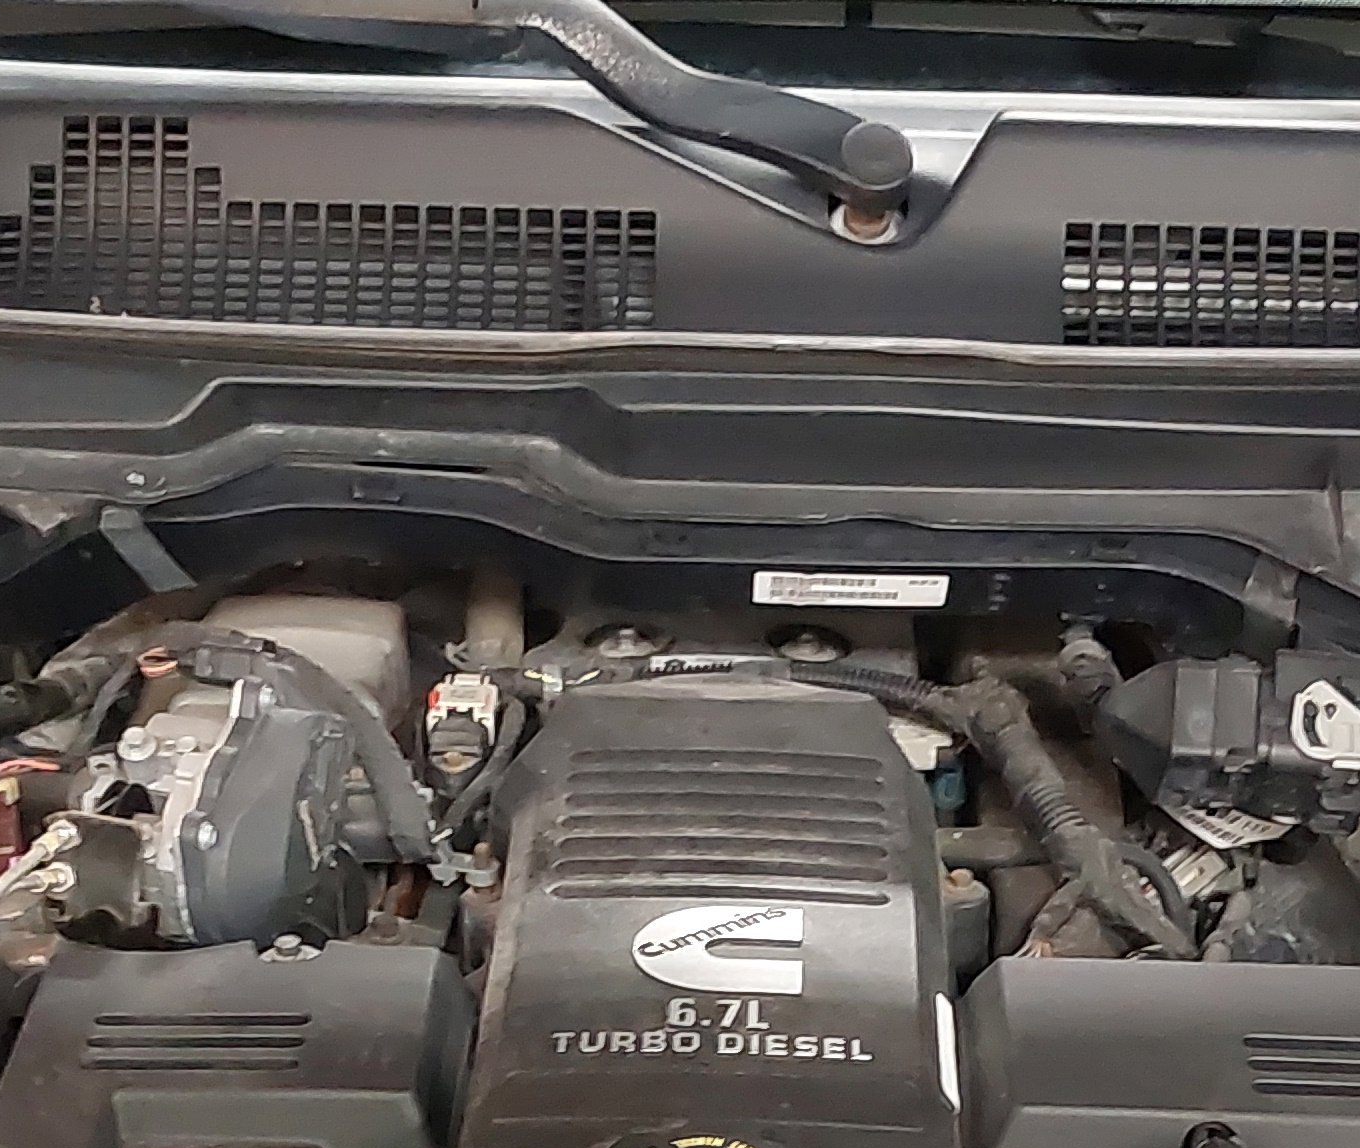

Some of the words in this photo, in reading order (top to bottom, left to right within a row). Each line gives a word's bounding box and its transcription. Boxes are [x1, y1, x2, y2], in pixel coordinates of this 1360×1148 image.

[638, 908, 786, 957] Cummins
[666, 997, 771, 1030] 6.7L
[551, 1031, 701, 1054] TURBO
[716, 1033, 873, 1061] DIESEL
